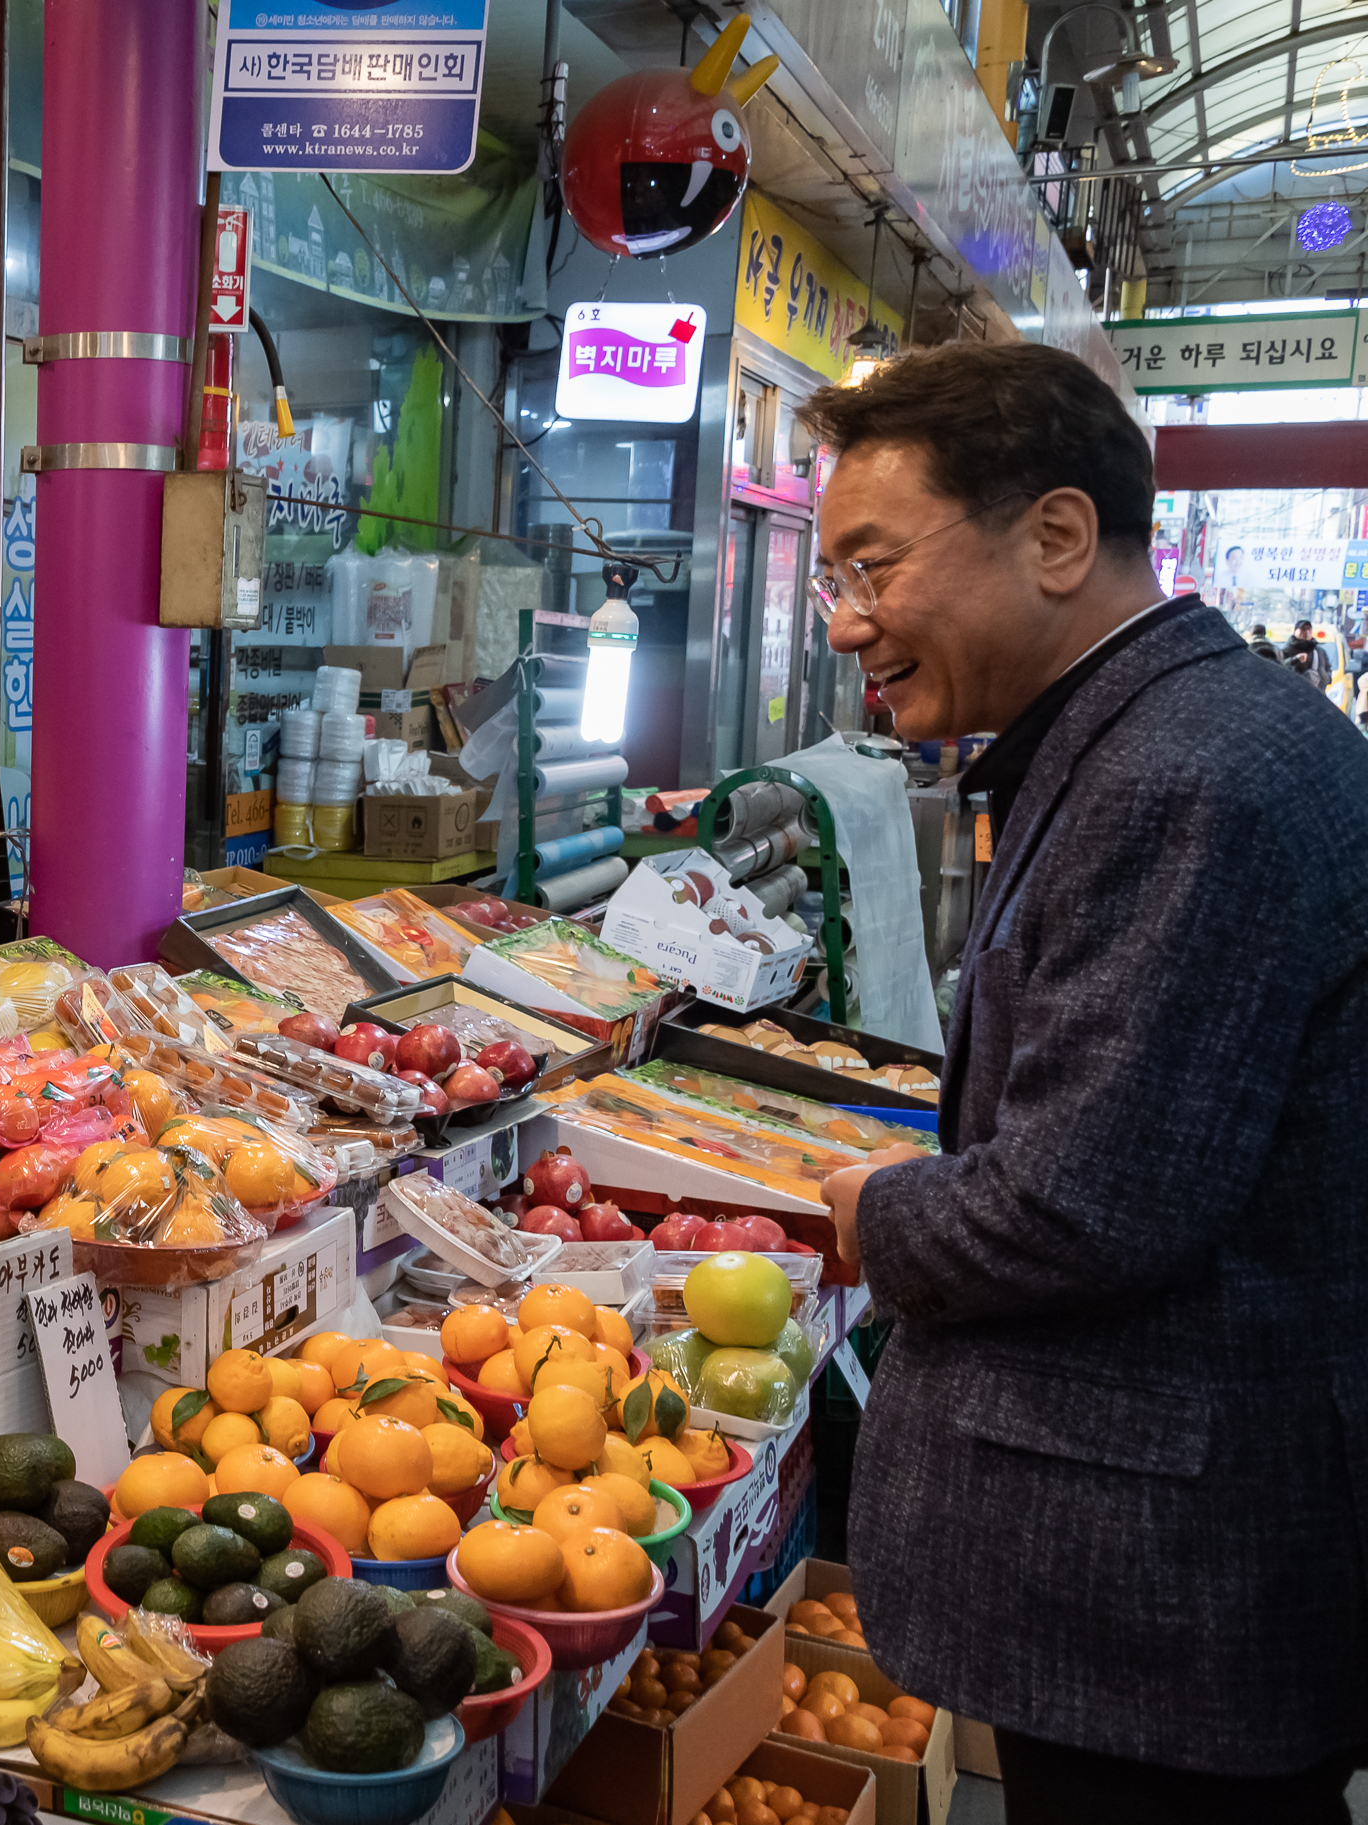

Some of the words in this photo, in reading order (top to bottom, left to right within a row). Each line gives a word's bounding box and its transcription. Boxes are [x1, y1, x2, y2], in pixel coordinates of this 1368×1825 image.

[297, 14, 349, 27] 청소년에게는
[351, 14, 378, 26] 담배를
[381, 13, 417, 26] 판매하지
[418, 13, 458, 26] 않습니다.
[261, 122, 303, 138] 콜센타
[332, 123, 424, 139] 1644-1785
[262, 141, 420, 156] www.ktranews.co.kr
[212, 274, 244, 290] 소화기
[574, 343, 678, 375] 벽지마루
[1114, 344, 1166, 371] 거운
[1179, 342, 1226, 368] 하루
[1239, 337, 1339, 366] 되십시요
[1251, 547, 1294, 562] 행복한
[1299, 547, 1342, 562] 설명절
[1267, 567, 1316, 583] 되세요!
[237, 648, 282, 680] 각종비닐
[657, 941, 698, 965] Pucara
[669, 966, 683, 974] CAT
[233, 1300, 259, 1326] 김경희
[69, 1353, 104, 1400] 5000
